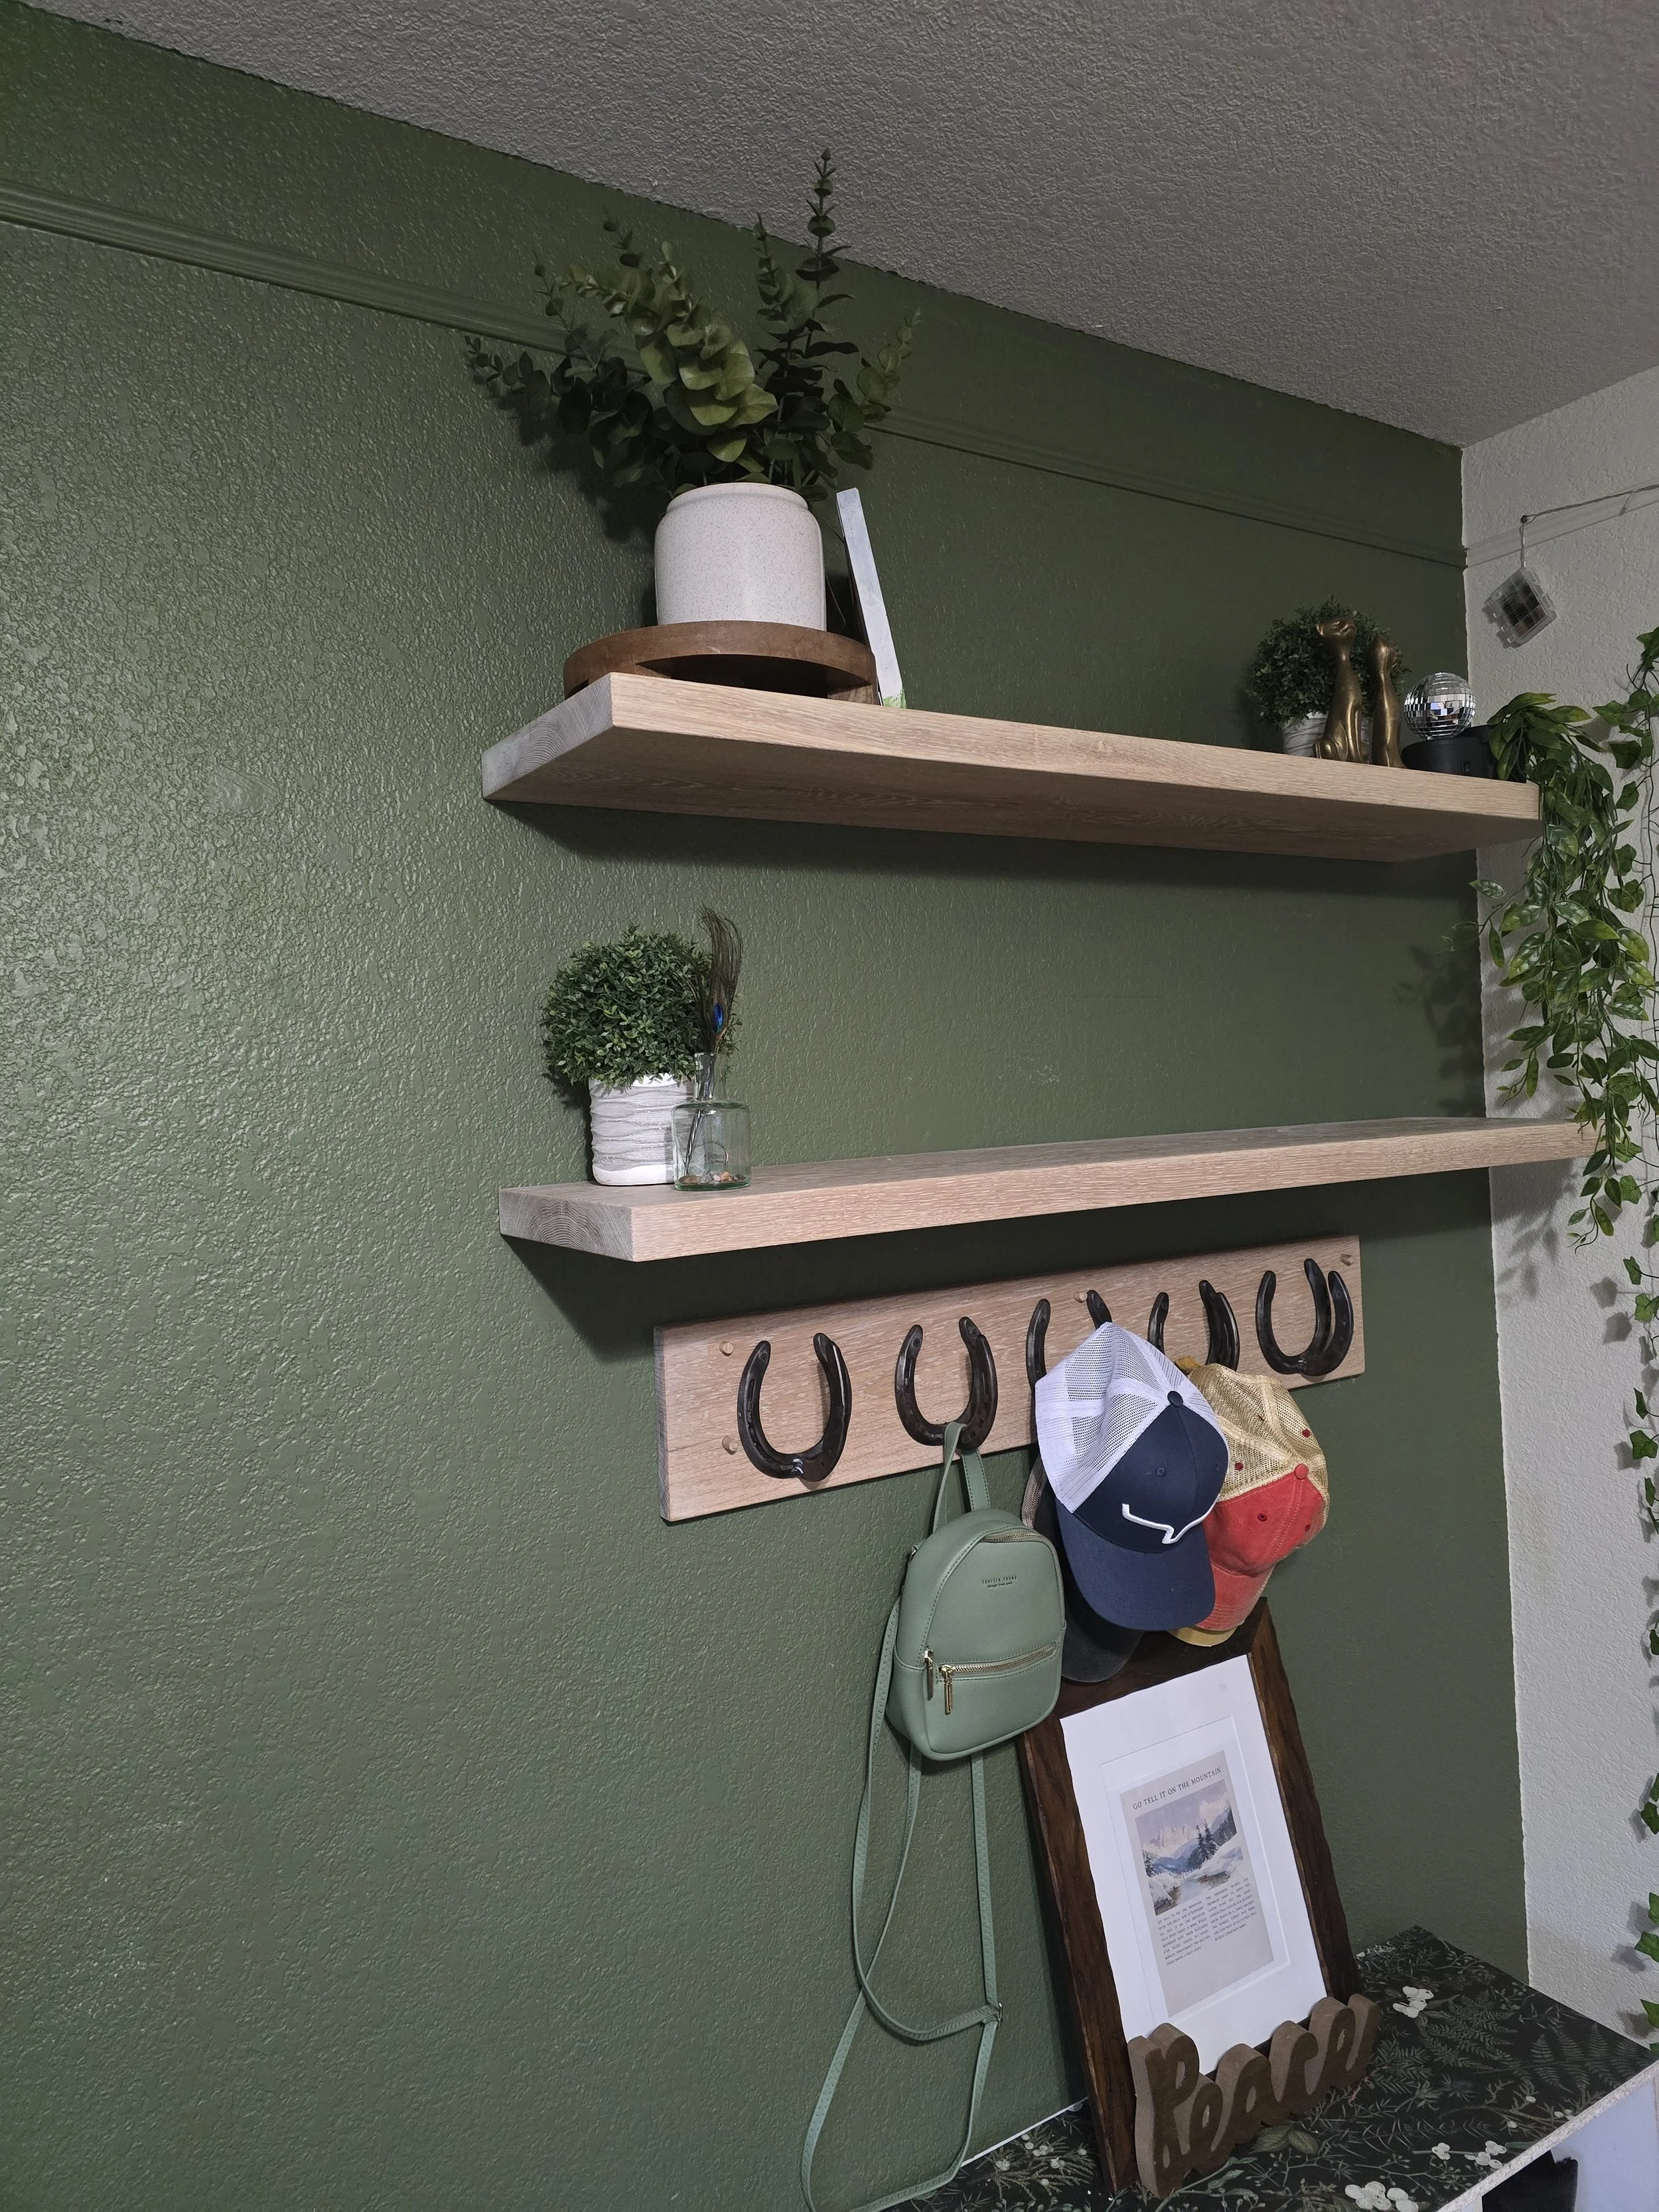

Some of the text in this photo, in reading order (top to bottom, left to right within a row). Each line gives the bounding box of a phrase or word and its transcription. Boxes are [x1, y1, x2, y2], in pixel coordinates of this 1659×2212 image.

[1133, 1767, 1222, 1810] GO TELL IT ON THE MOUNTAIN
